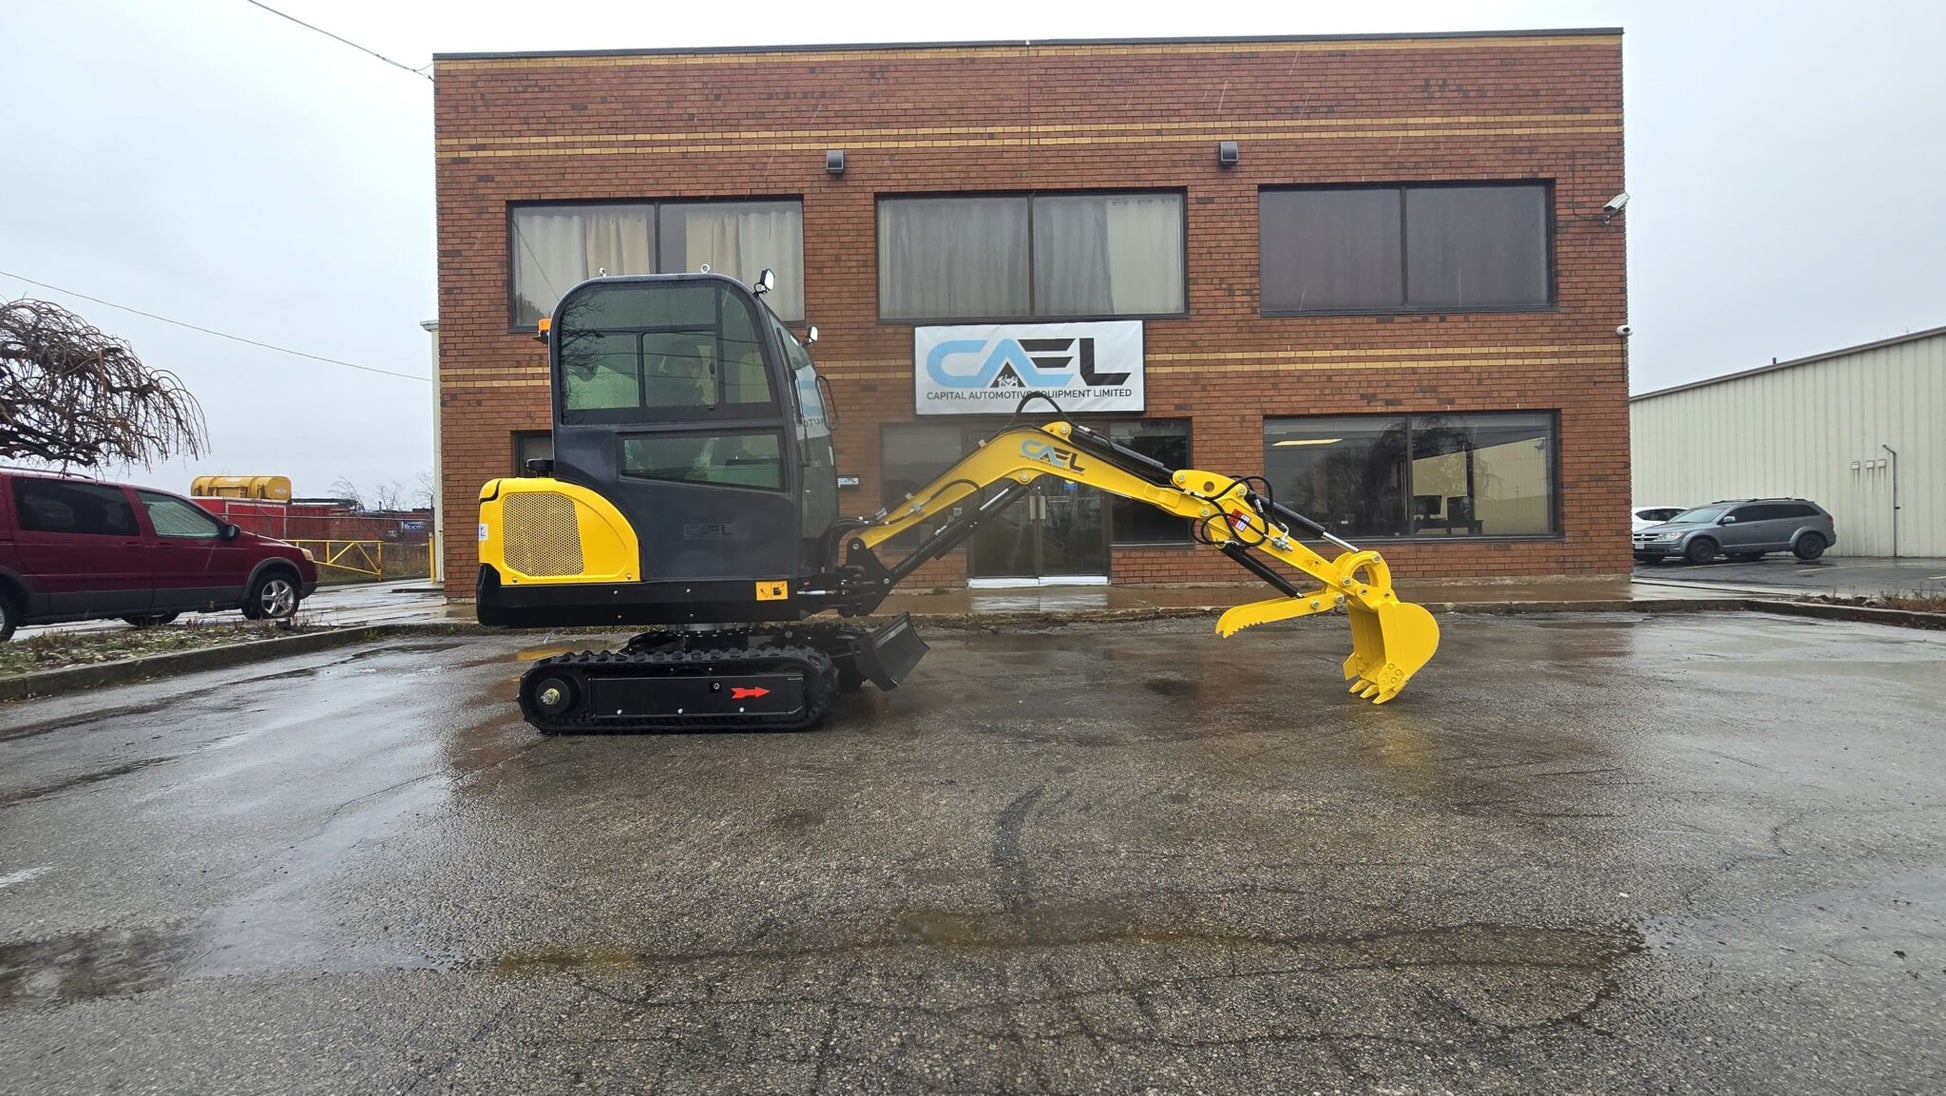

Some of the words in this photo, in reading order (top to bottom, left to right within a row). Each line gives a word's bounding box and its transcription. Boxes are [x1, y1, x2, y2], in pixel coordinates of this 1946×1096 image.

[926, 338, 1131, 388] CAEL
[927, 391, 967, 400] CAPITAL
[1034, 389, 1091, 399] QUIPMENT
[1093, 388, 1132, 398] LIMITED
[1021, 440, 1086, 472] CAEL
